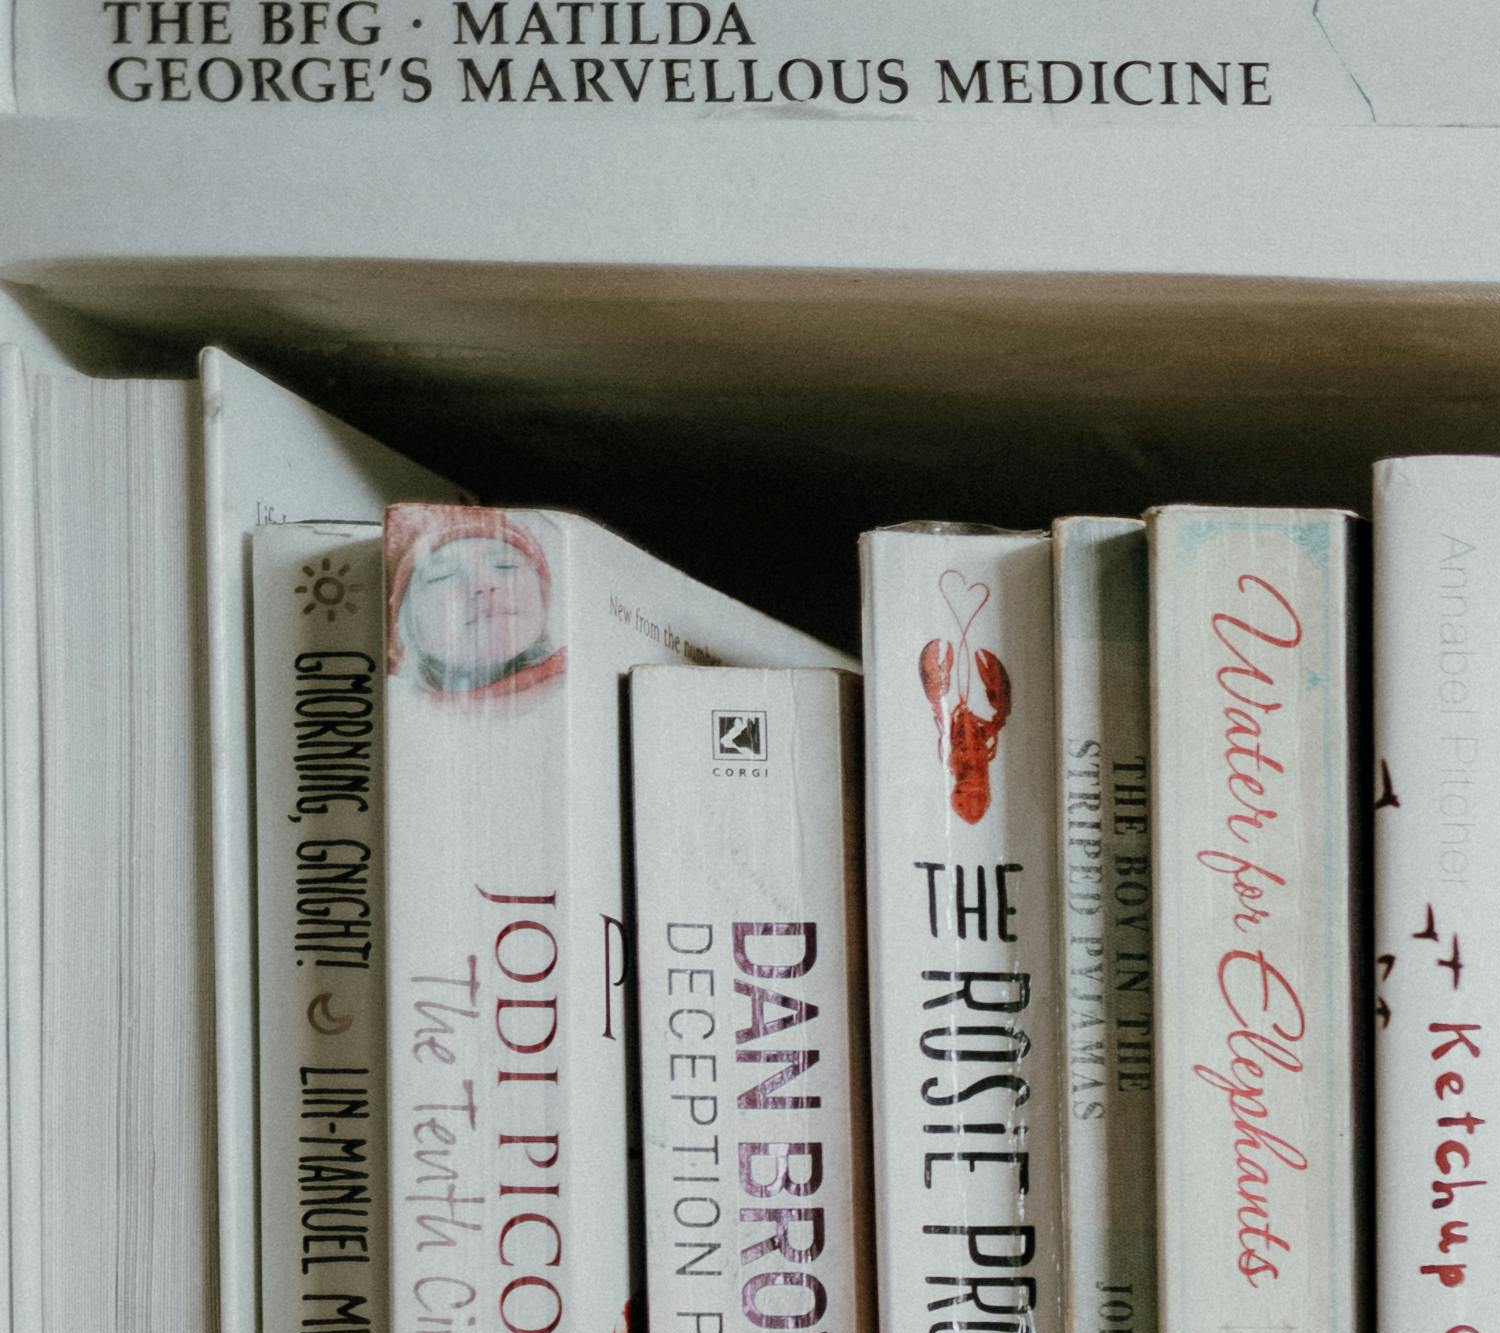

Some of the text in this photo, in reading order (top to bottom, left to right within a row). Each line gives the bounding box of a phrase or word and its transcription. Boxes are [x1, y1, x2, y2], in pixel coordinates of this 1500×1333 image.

[106, 0, 755, 46] THE BFG MATILDA
[106, 57, 1272, 107] GEORGE'S MARVELLOUS MEDICINE
[289, 650, 374, 824] GMORNING,
[712, 767, 770, 778] CORGI
[294, 840, 371, 969] GNIGHT!
[474, 884, 560, 1086] JODI
[914, 861, 1023, 942] THE
[666, 923, 723, 1276] DECEPTION
[731, 922, 822, 1109] DAN
[298, 1066, 372, 1275] LIN-MANUEL
[1420, 1022, 1487, 1287] Ketchup
